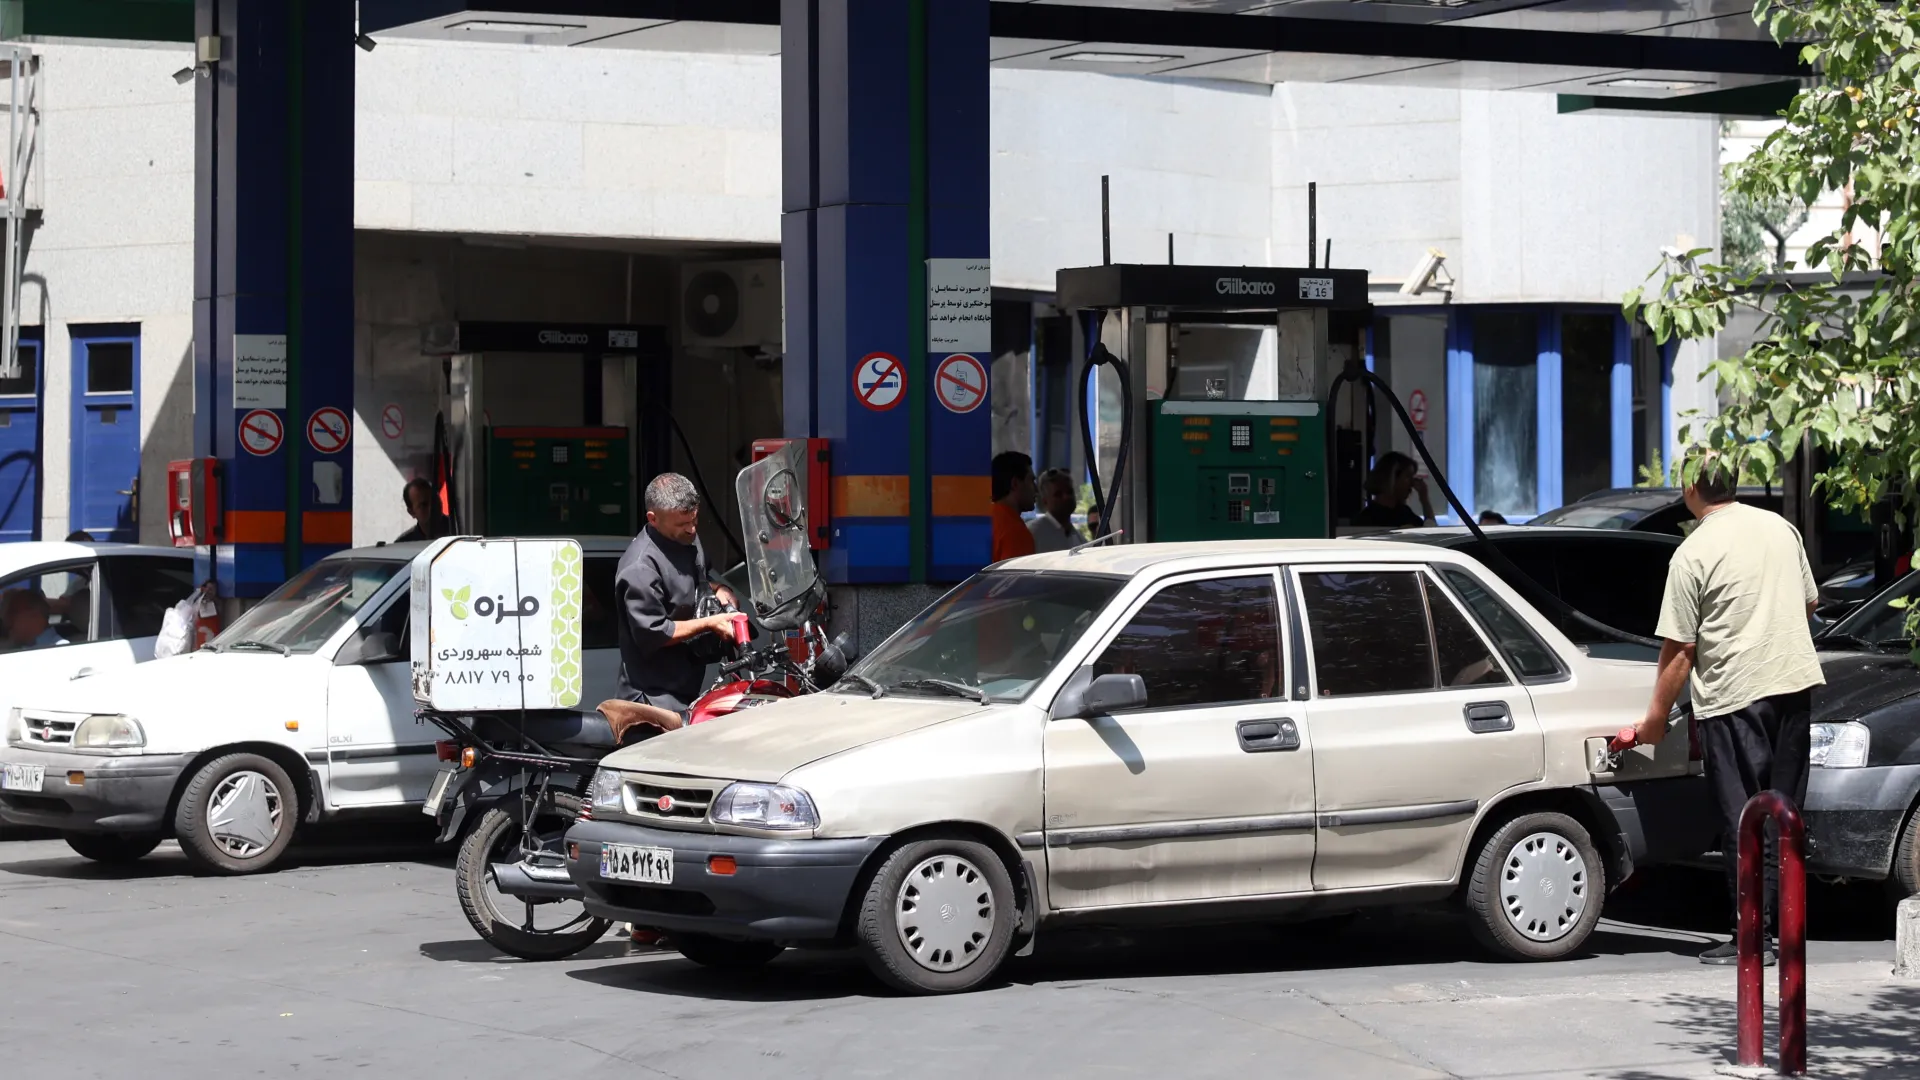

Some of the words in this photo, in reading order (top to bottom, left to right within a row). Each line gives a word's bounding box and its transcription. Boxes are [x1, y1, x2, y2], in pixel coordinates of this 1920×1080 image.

[1215, 277, 1275, 294] Gilbarco
[1315, 288, 1327, 298] 16
[947, 299, 962, 308] توسط
[940, 314, 957, 323] خواهد
[958, 314, 973, 323] انجام
[474, 595, 540, 624] مزه
[437, 648, 502, 660] سهروردی
[506, 645, 542, 660] شعبه
